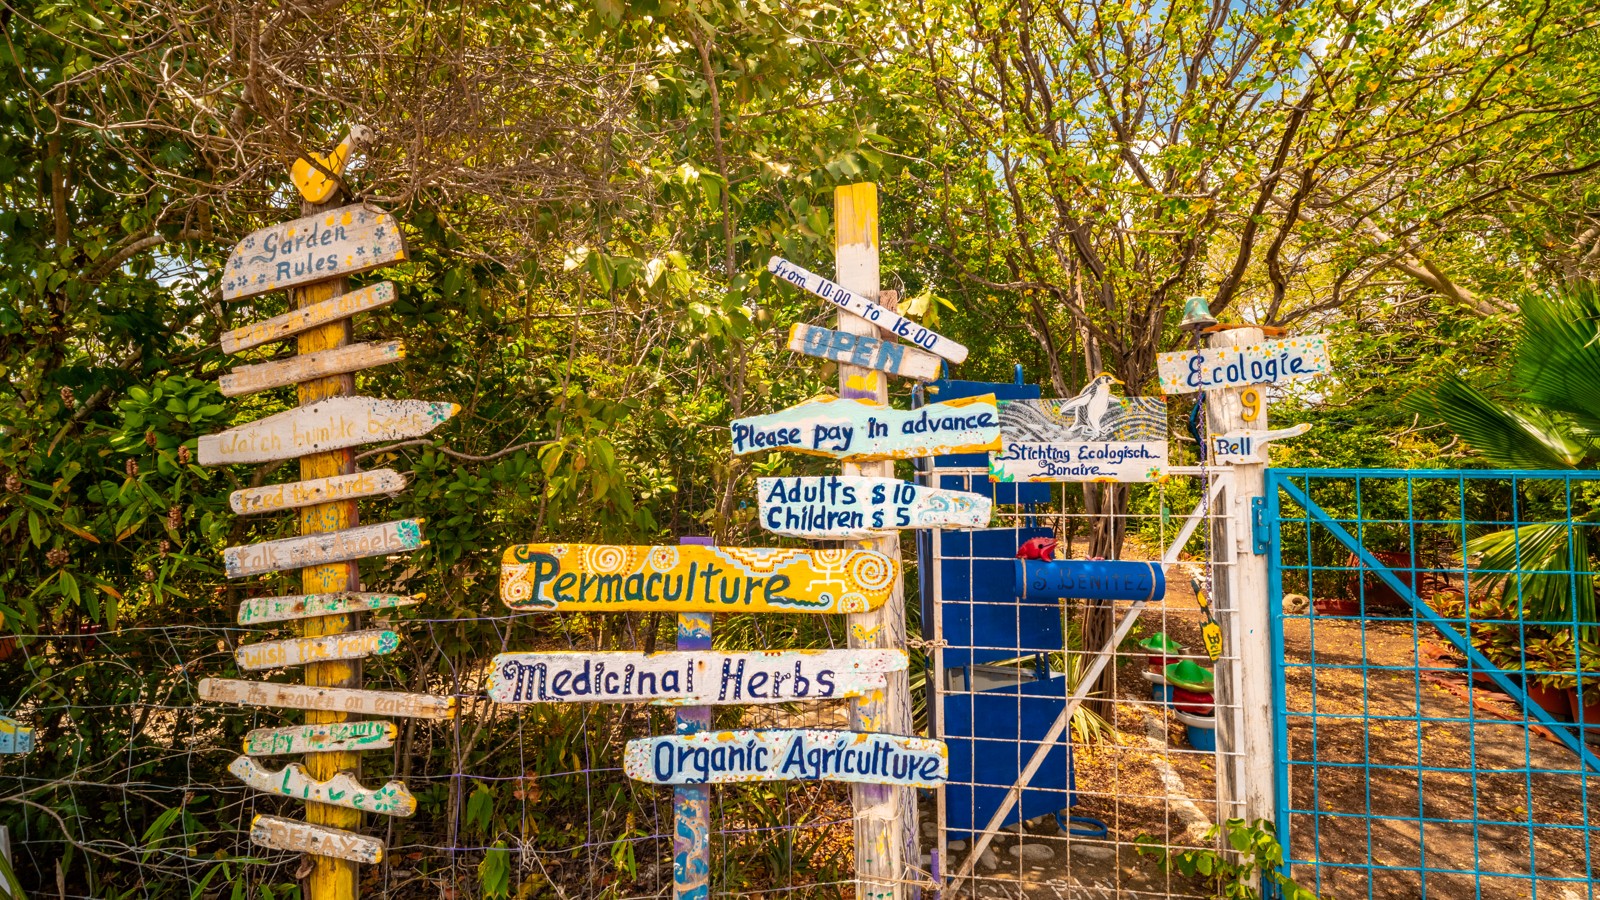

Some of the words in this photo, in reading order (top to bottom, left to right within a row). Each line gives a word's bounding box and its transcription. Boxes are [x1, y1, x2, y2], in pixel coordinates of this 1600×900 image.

[255, 222, 348, 262] Garden
[276, 253, 338, 281] Rules
[233, 323, 275, 348] Play
[338, 287, 376, 312] dirt
[771, 260, 806, 289] from
[816, 279, 852, 307] 10:00
[863, 303, 880, 321] to
[892, 317, 938, 350] 16:00
[803, 325, 906, 374] OPEN
[1187, 353, 1318, 385] Ecologie
[1241, 388, 1260, 423] 9
[219, 427, 281, 456] Watch
[292, 415, 355, 448] bumble
[732, 422, 802, 450] Please
[813, 423, 853, 451] pay
[901, 411, 1000, 434] advance
[1216, 436, 1251, 457] Bell
[1000, 443, 1070, 463] Stichting
[1078, 443, 1156, 464] Ecologisch
[1033, 460, 1106, 477] Bonaire
[292, 484, 319, 502] the
[326, 473, 375, 498] birds
[765, 476, 857, 505] Adults
[872, 483, 886, 505] $
[893, 484, 916, 505] 10
[767, 504, 863, 531] Children
[872, 508, 884, 528] $
[896, 507, 911, 527] 5
[330, 528, 401, 559] Angels
[516, 552, 810, 606] Permaculture
[299, 640, 329, 663] the
[338, 636, 378, 655] rain
[502, 659, 694, 702] Medicinal
[719, 658, 835, 701] Herbs
[345, 695, 363, 710] on
[654, 739, 770, 784] Organic
[781, 736, 946, 781] Agriculture
[281, 767, 366, 809] Live
